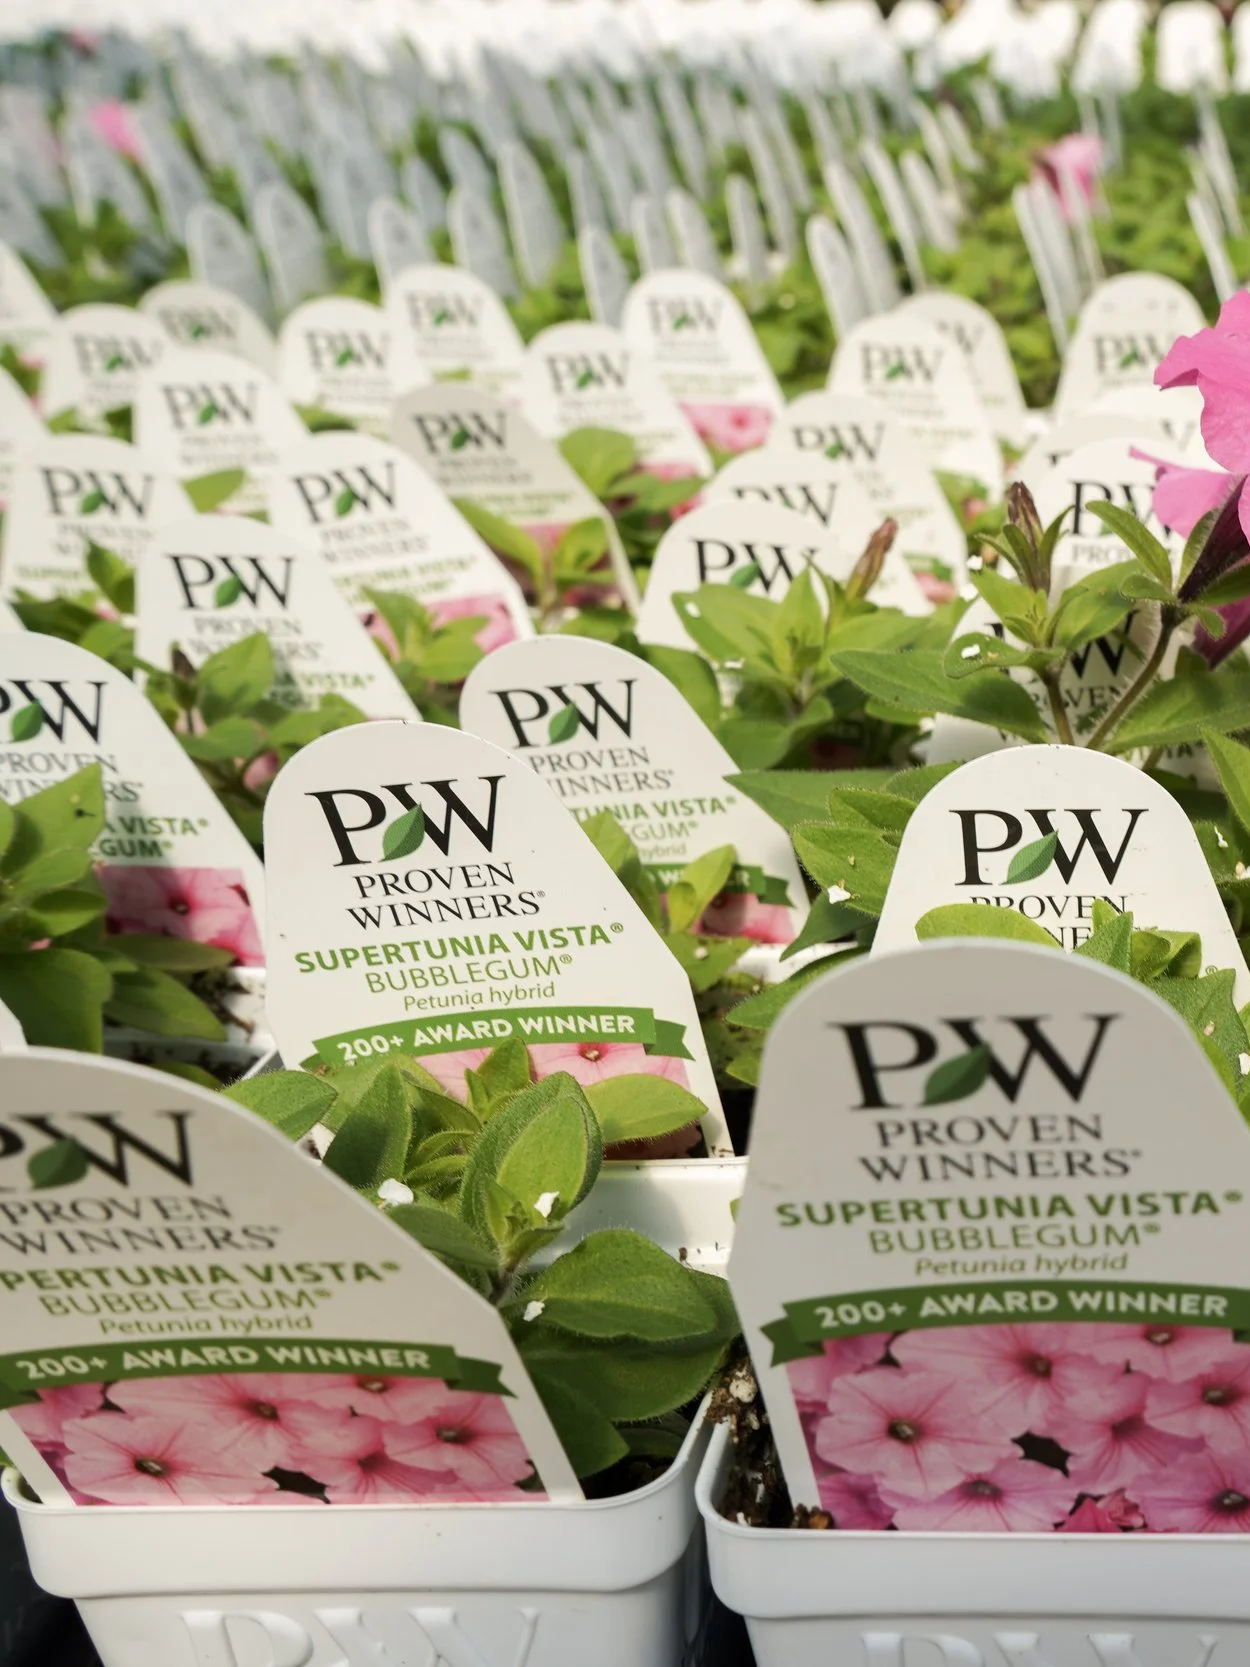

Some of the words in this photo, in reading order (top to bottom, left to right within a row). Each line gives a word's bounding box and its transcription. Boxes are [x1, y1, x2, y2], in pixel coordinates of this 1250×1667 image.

[414, 410, 508, 453] PW
[40, 466, 154, 517] PW
[293, 462, 398, 525] PW
[168, 554, 294, 610] PW
[488, 678, 639, 750] PW
[528, 746, 652, 775] PROVEN
[546, 769, 671, 799] INNERS
[303, 774, 507, 868] PW
[948, 807, 1150, 886] PW
[352, 861, 516, 900] PROVEN
[294, 932, 511, 974] SUPERTUNIA
[402, 990, 484, 1013] Petunia
[489, 981, 556, 1007] hybrid
[336, 1035, 405, 1065] 200+
[412, 1018, 513, 1049] AWARD
[517, 1014, 637, 1037] WINNER
[827, 1011, 1128, 1112] PW
[0, 1110, 198, 1192] W
[875, 1113, 1105, 1149] PROVEN
[0, 1195, 234, 1227] PROVEN
[775, 1192, 1078, 1229] SUPERTUNIA
[914, 1255, 1027, 1279] Petunia
[1034, 1251, 1129, 1276] hybrid
[98, 1317, 213, 1336] Petunia
[220, 1314, 313, 1336] hybrid
[815, 1299, 908, 1329] 200+
[918, 1289, 1059, 1319] AWARD
[1066, 1289, 1229, 1319] WINNER
[15, 1356, 109, 1380] 200+
[121, 1346, 260, 1371] AWARD
[265, 1345, 433, 1370] WINNER
